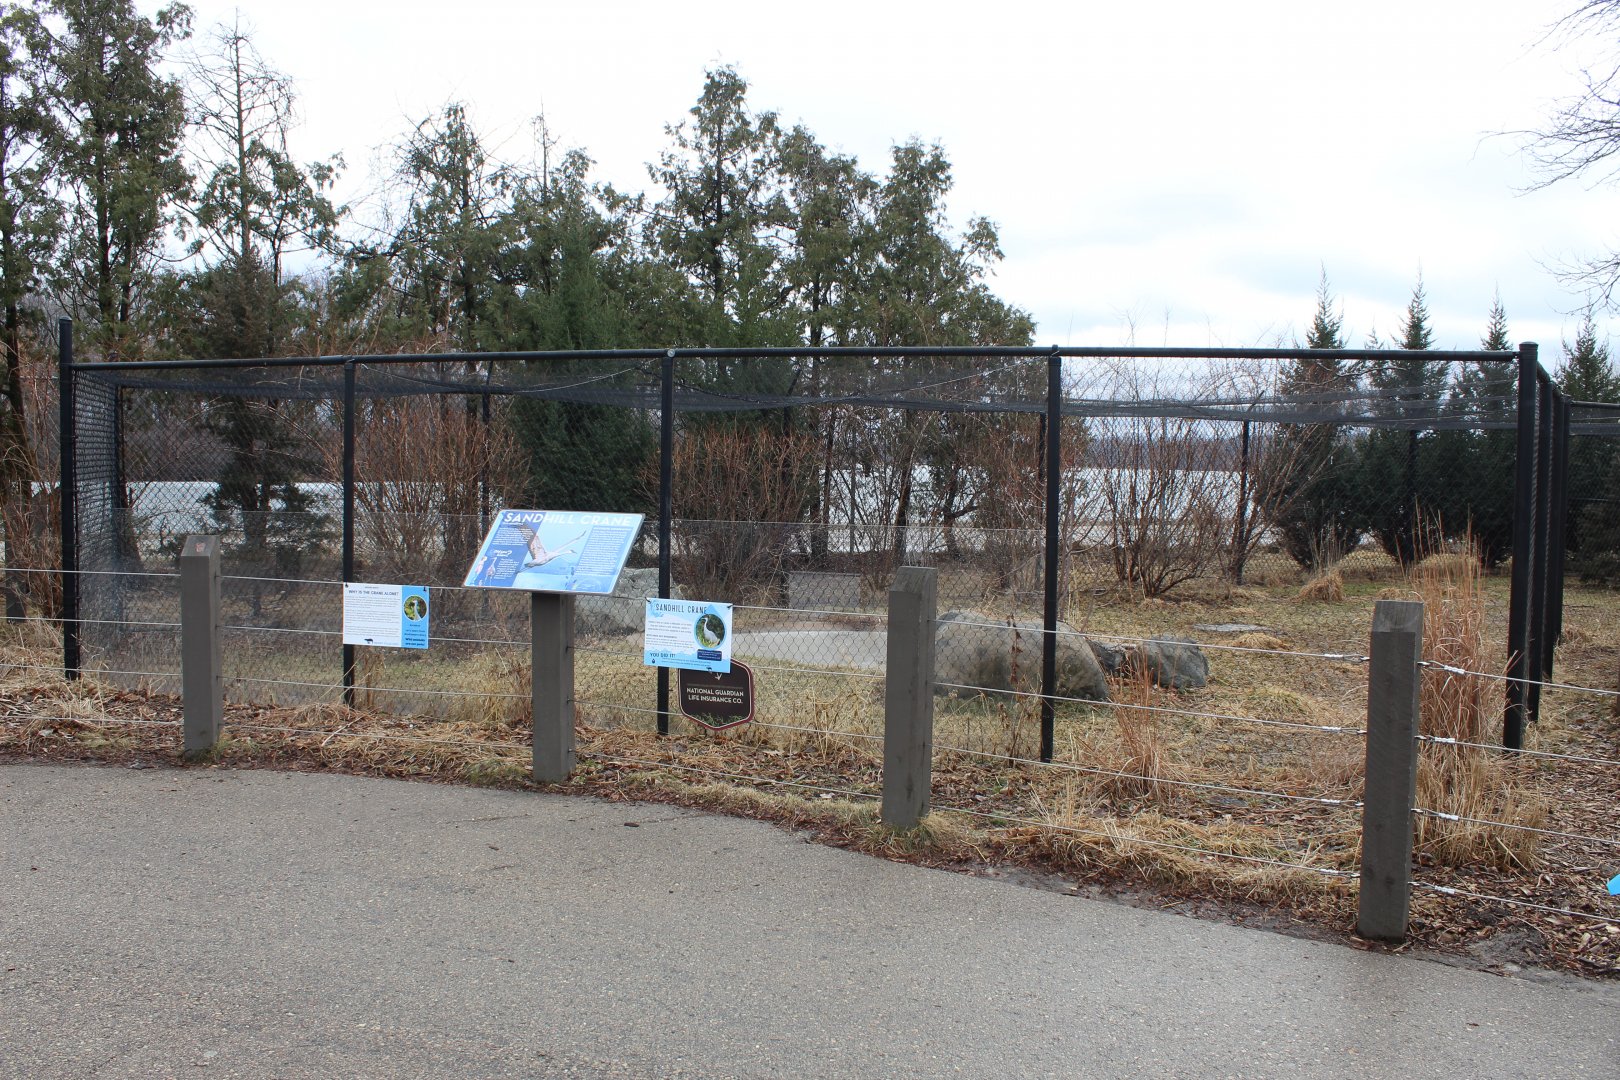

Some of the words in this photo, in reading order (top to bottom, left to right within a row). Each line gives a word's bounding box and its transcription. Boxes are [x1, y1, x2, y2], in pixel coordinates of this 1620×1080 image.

[504, 512, 575, 524] SANDHILL
[579, 515, 633, 526] CRANE
[656, 603, 684, 613] SANDHILL
[687, 605, 707, 614] CRANE
[686, 687, 714, 695] NATIONAL
[715, 689, 744, 697] GUARDIAN
[700, 695, 732, 703] INSURANCE
